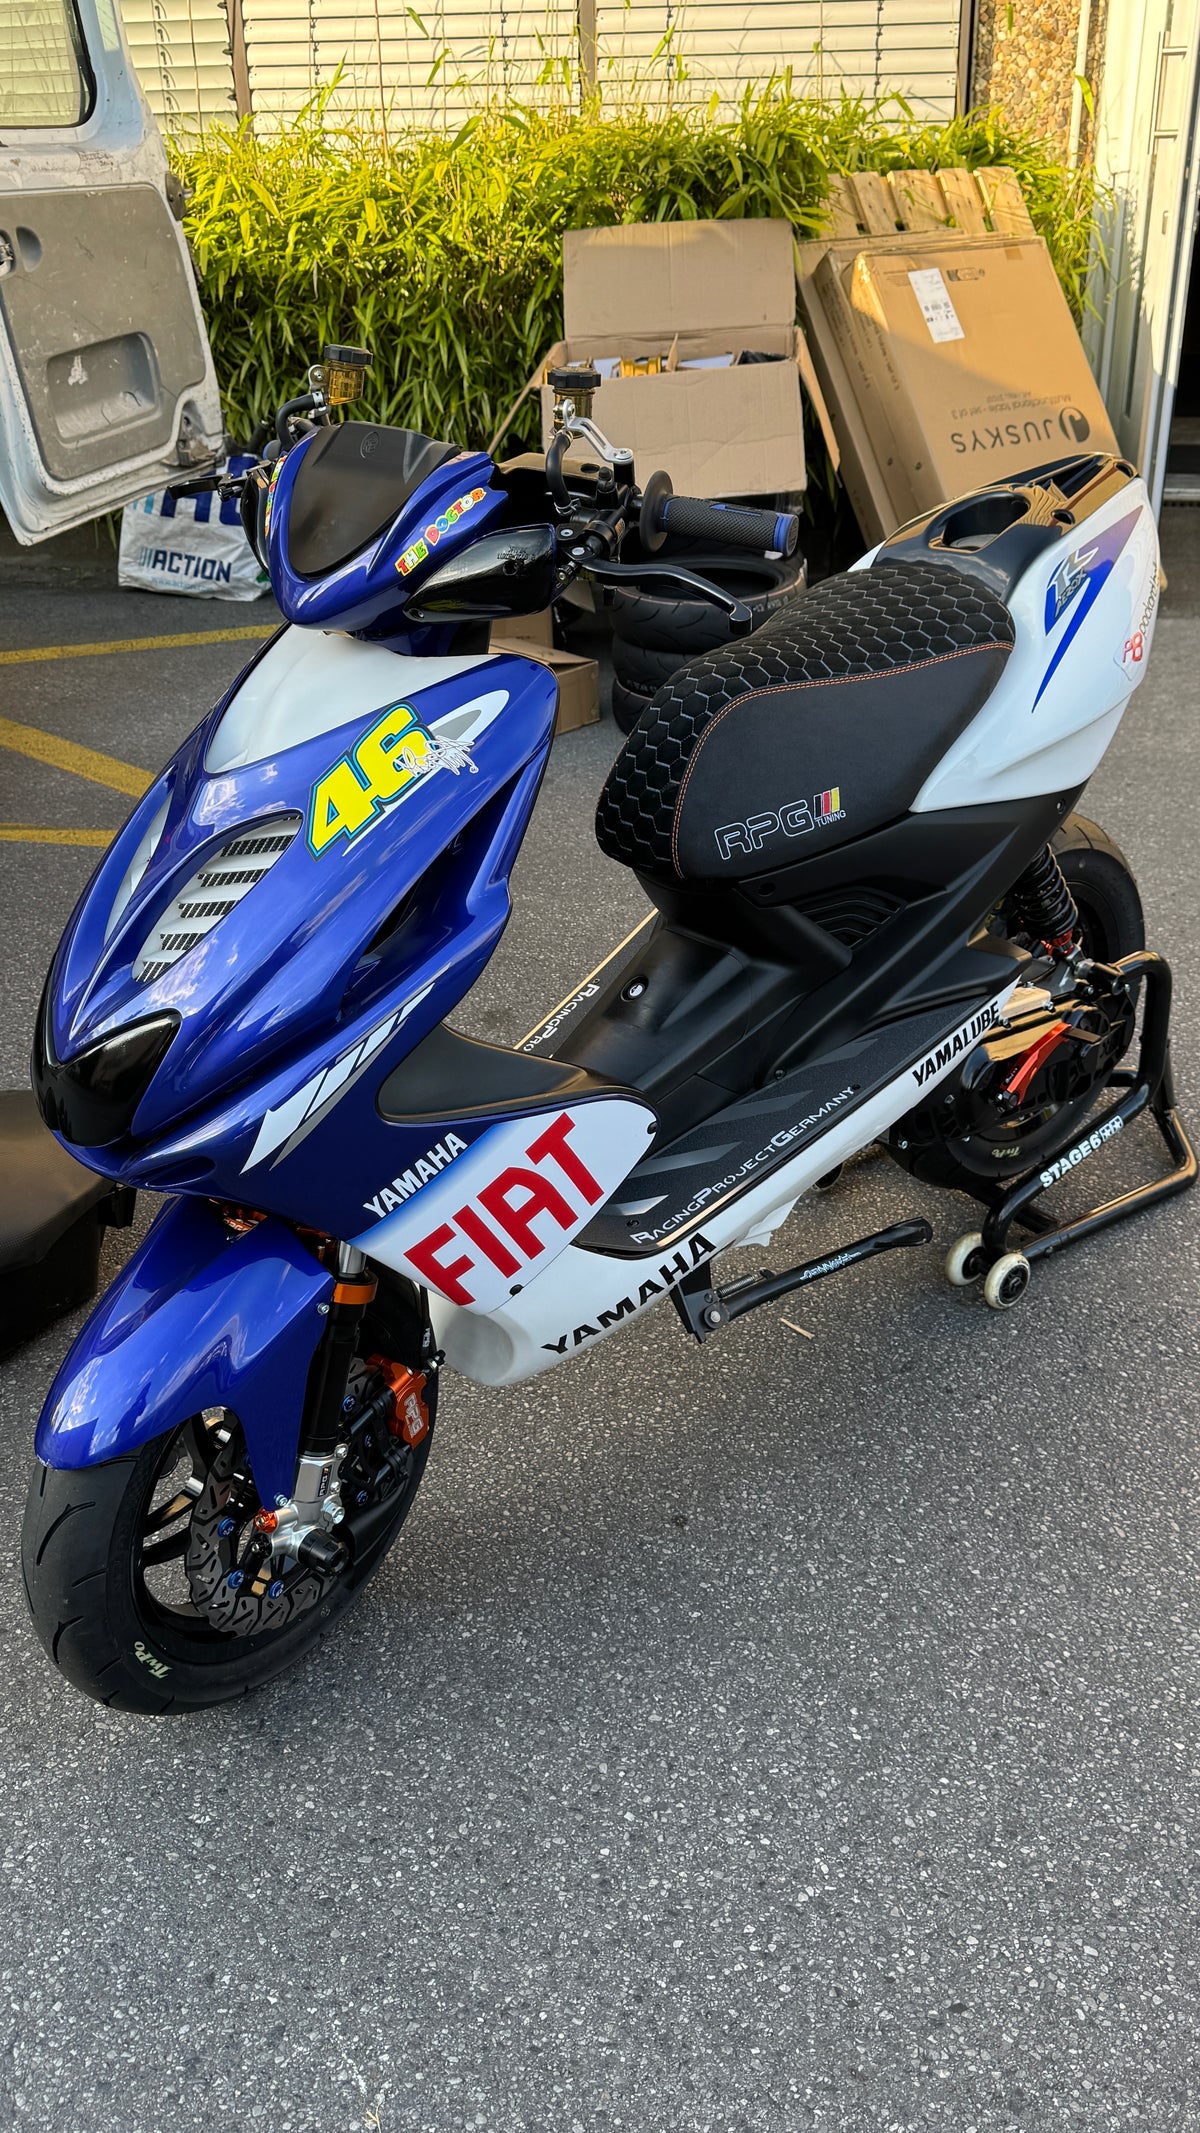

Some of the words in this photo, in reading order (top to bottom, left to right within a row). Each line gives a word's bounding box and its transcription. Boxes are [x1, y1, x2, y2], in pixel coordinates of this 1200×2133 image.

[951, 418, 1053, 453] JUSKYS
[151, 549, 232, 583] ACTION
[394, 537, 430, 577] THE
[424, 487, 487, 546] DOCTOR
[306, 702, 438, 860] 46
[815, 809, 847, 828] TUNING
[714, 799, 815, 860] RPG
[912, 1000, 1000, 1087] YAMALUBE
[362, 1132, 468, 1219] YAMAHA
[403, 1111, 605, 1307] FIAT
[541, 1232, 717, 1354] YAMAHA
[404, 1392, 425, 1438] RPG
